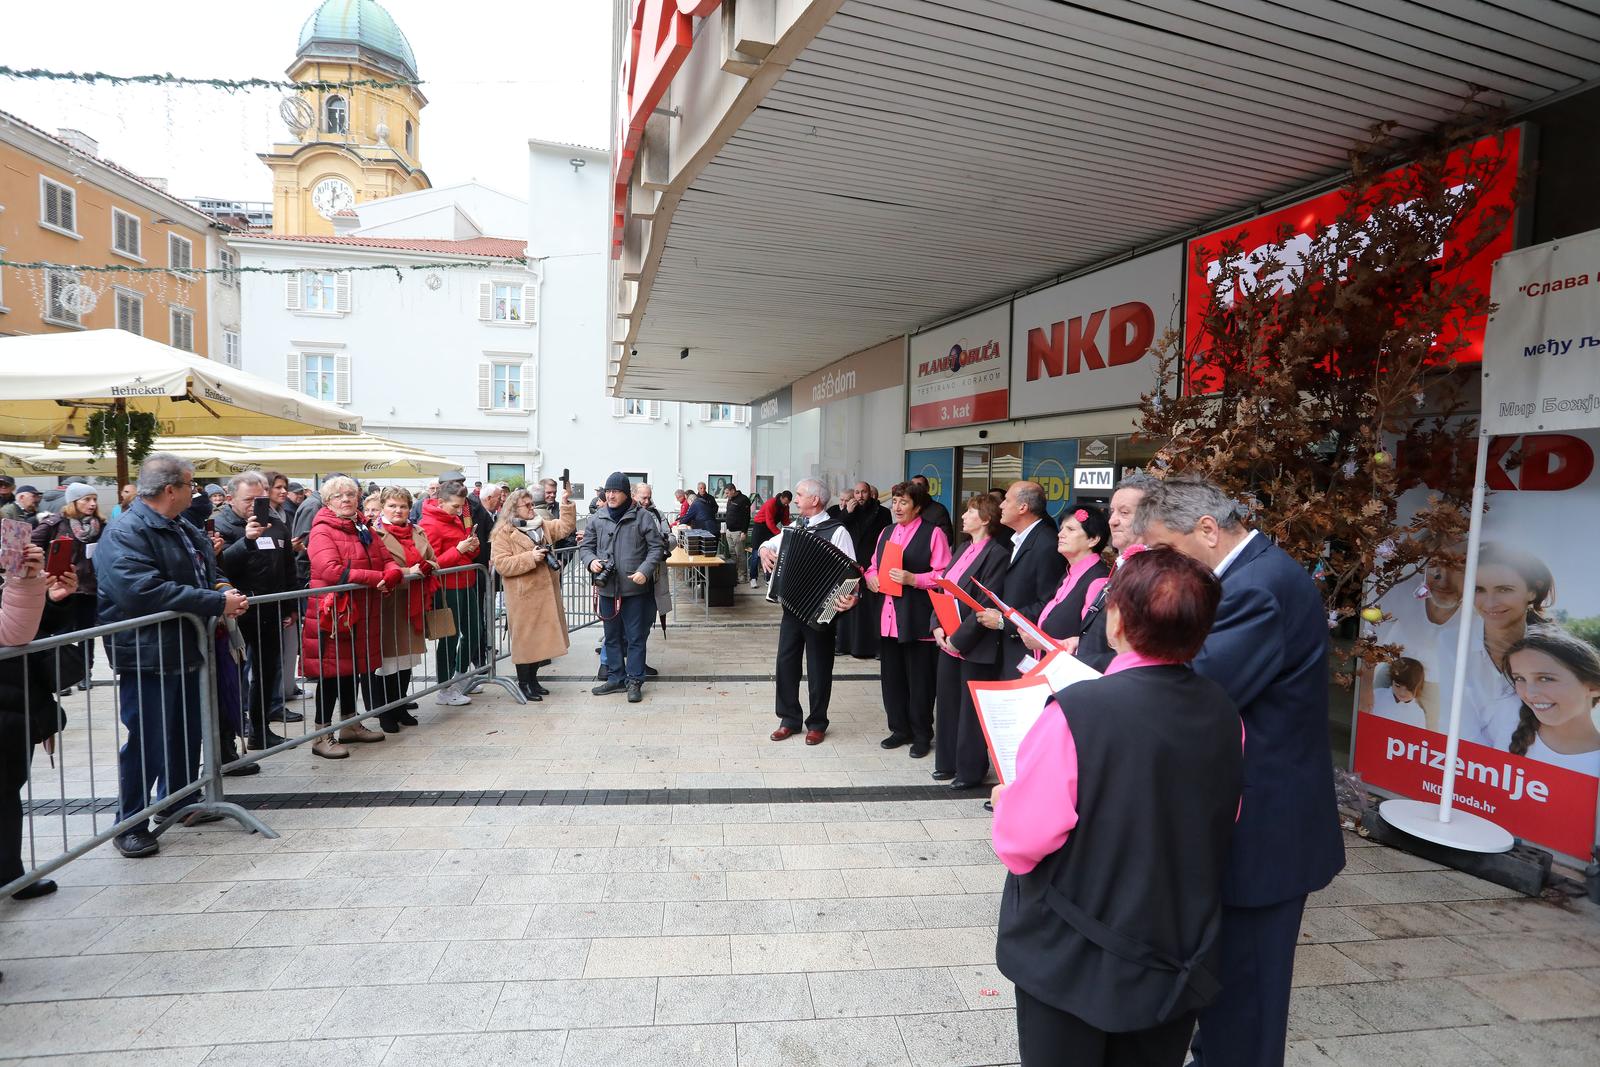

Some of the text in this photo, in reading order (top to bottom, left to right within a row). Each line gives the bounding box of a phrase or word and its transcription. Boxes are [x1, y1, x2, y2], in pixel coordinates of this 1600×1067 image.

[1026, 301, 1155, 382] NKD
[1523, 338, 1573, 357] међу
[918, 340, 1001, 378] PLANET OBUĆA
[111, 386, 165, 396] Heineken
[941, 403, 970, 420] 3. kat
[1499, 401, 1537, 418] Мир
[1079, 471, 1111, 485] ATM
[1386, 736, 1549, 803] prizemlje
[1422, 780, 1497, 814] NKDmoda.hr
